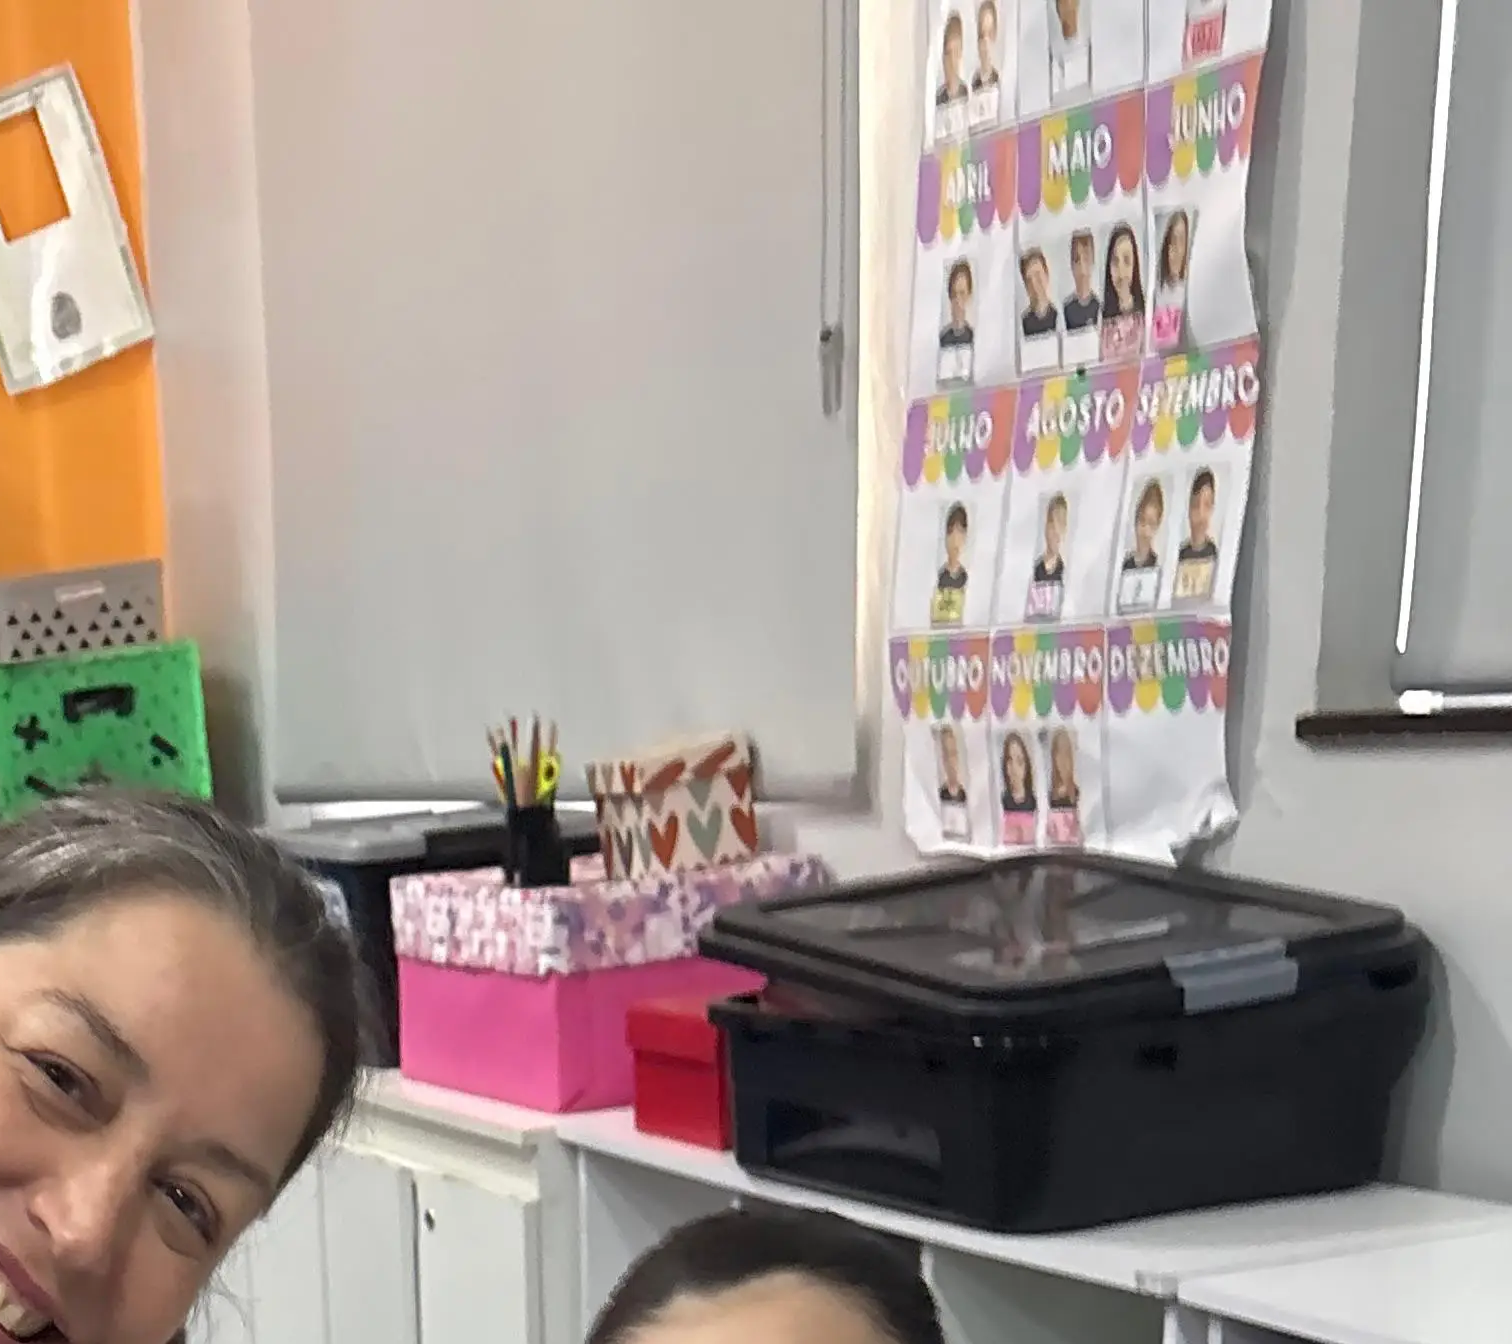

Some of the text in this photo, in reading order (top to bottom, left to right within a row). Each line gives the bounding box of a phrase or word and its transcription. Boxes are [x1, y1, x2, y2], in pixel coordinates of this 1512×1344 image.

[1047, 123, 1113, 180] MAIO
[1168, 82, 1246, 152] JUNHO
[1025, 387, 1126, 442] AGOSTO
[1135, 359, 1261, 423] SETEMBRO
[894, 629, 1230, 692] OUTUBRO NOVEMBRO DEZEMBRO
